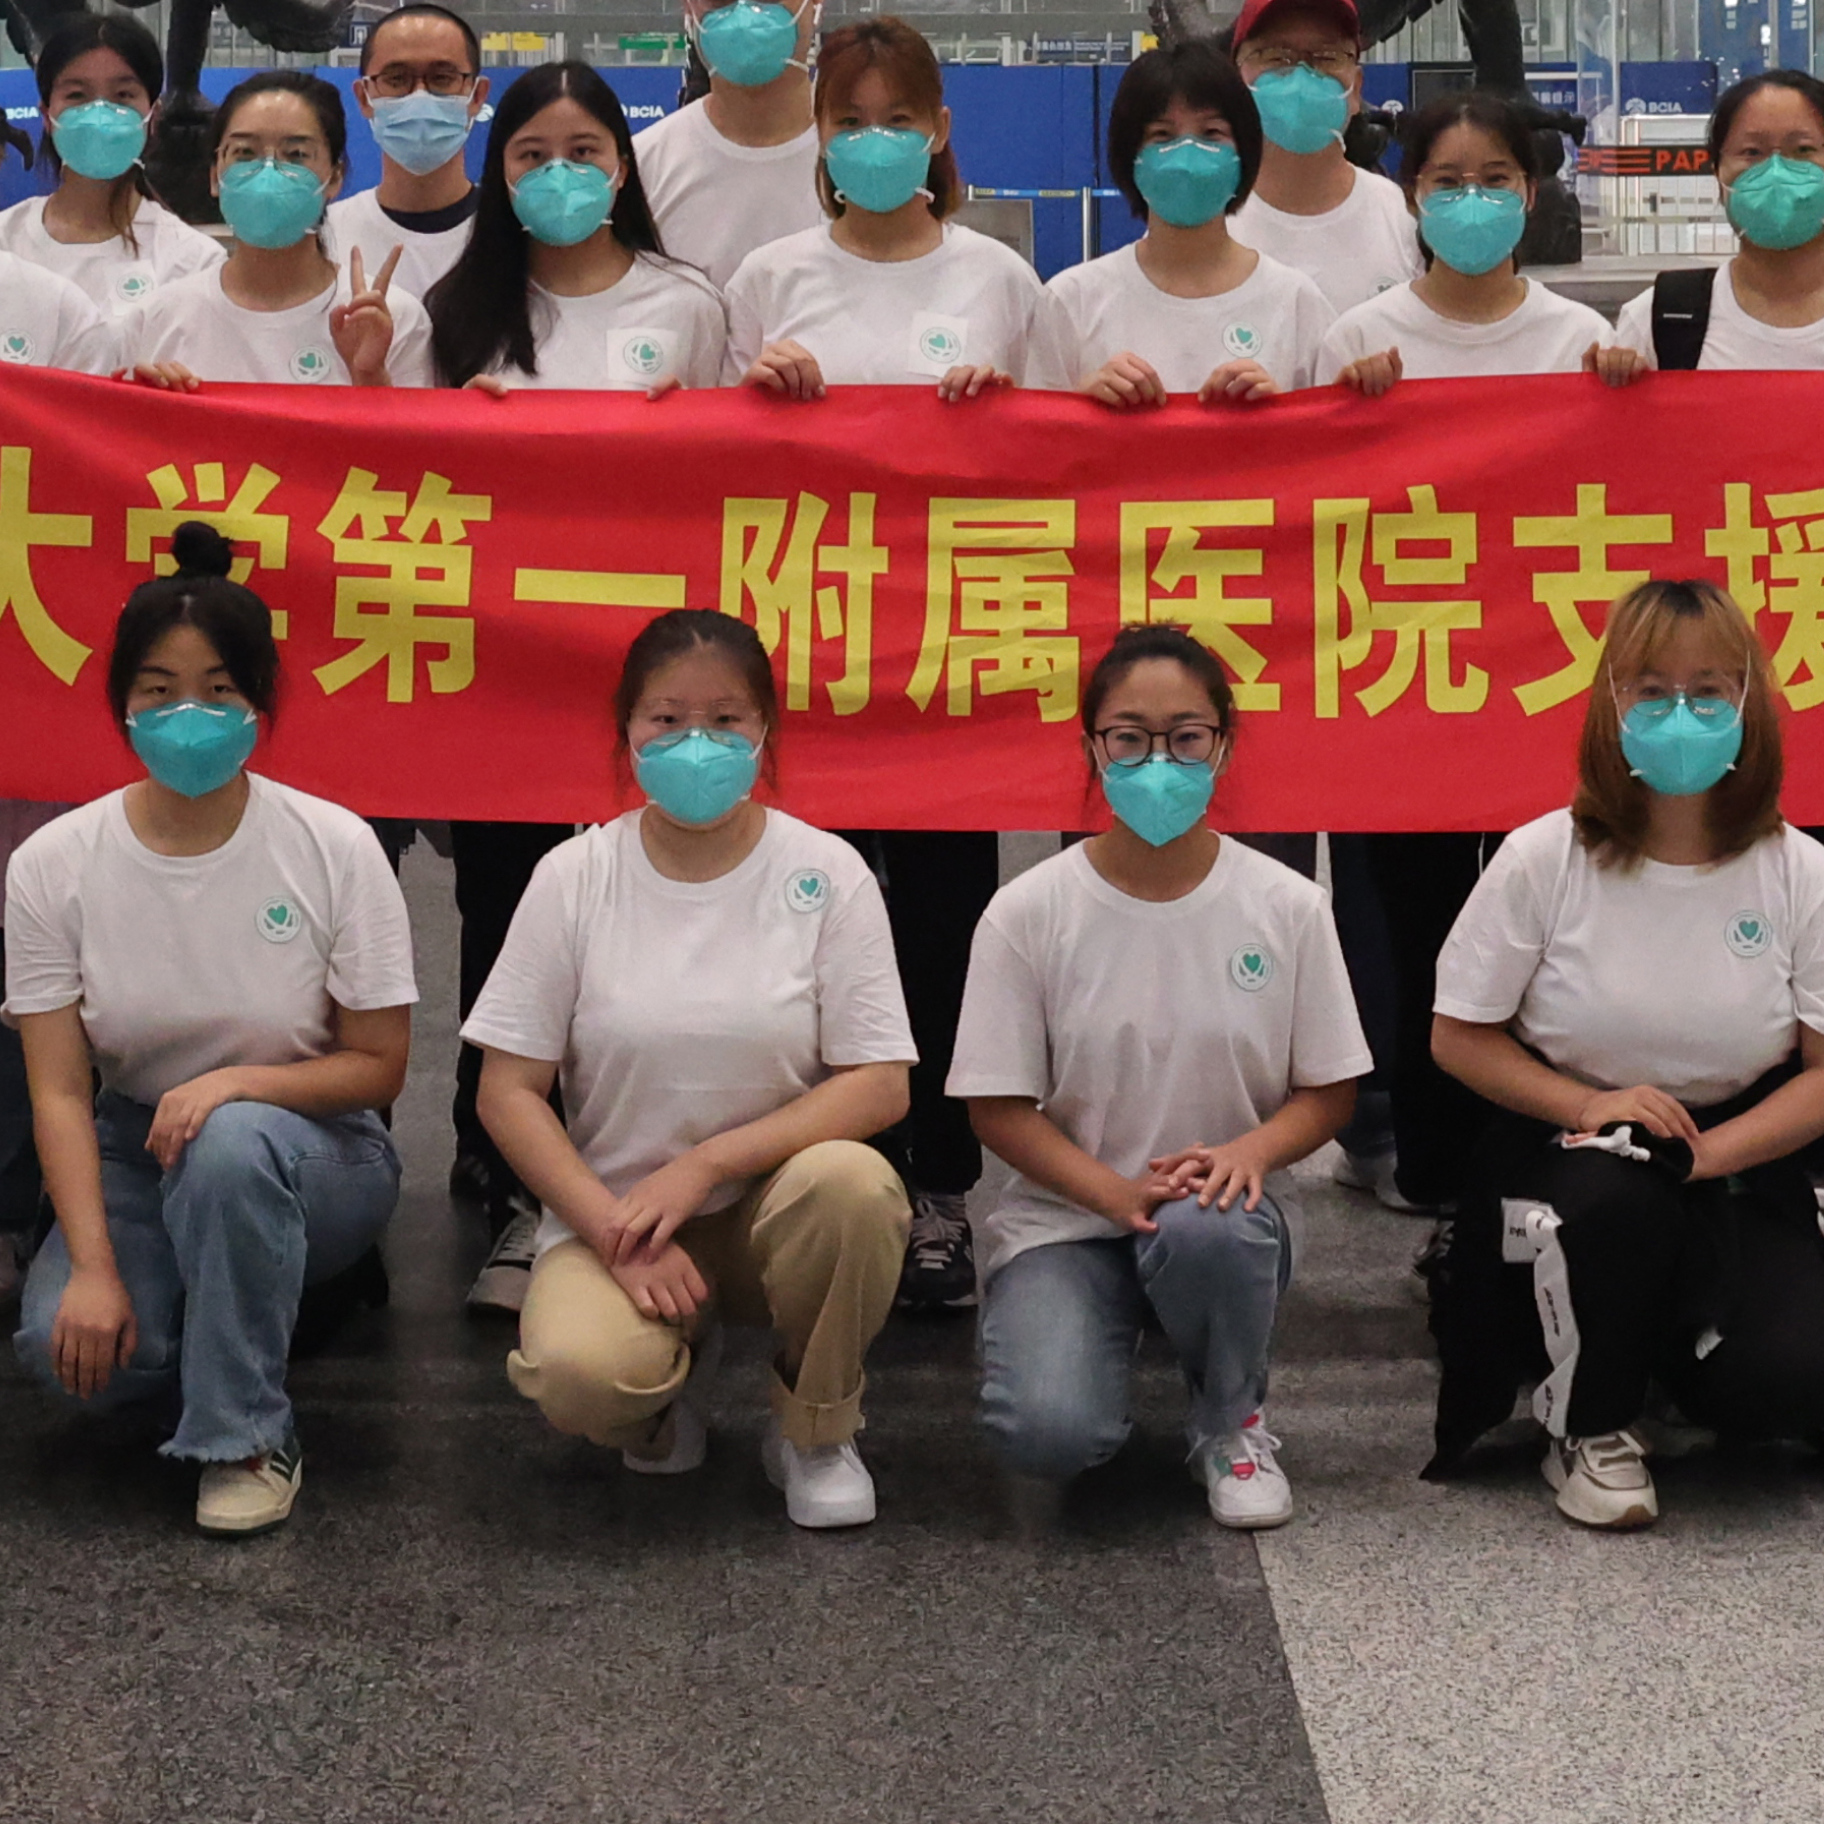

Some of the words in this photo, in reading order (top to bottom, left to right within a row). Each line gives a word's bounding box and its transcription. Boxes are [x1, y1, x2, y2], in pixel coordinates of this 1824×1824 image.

[5, 107, 39, 118] BCIA
[630, 105, 664, 118] BCIA
[1648, 102, 1682, 113] BCIA
